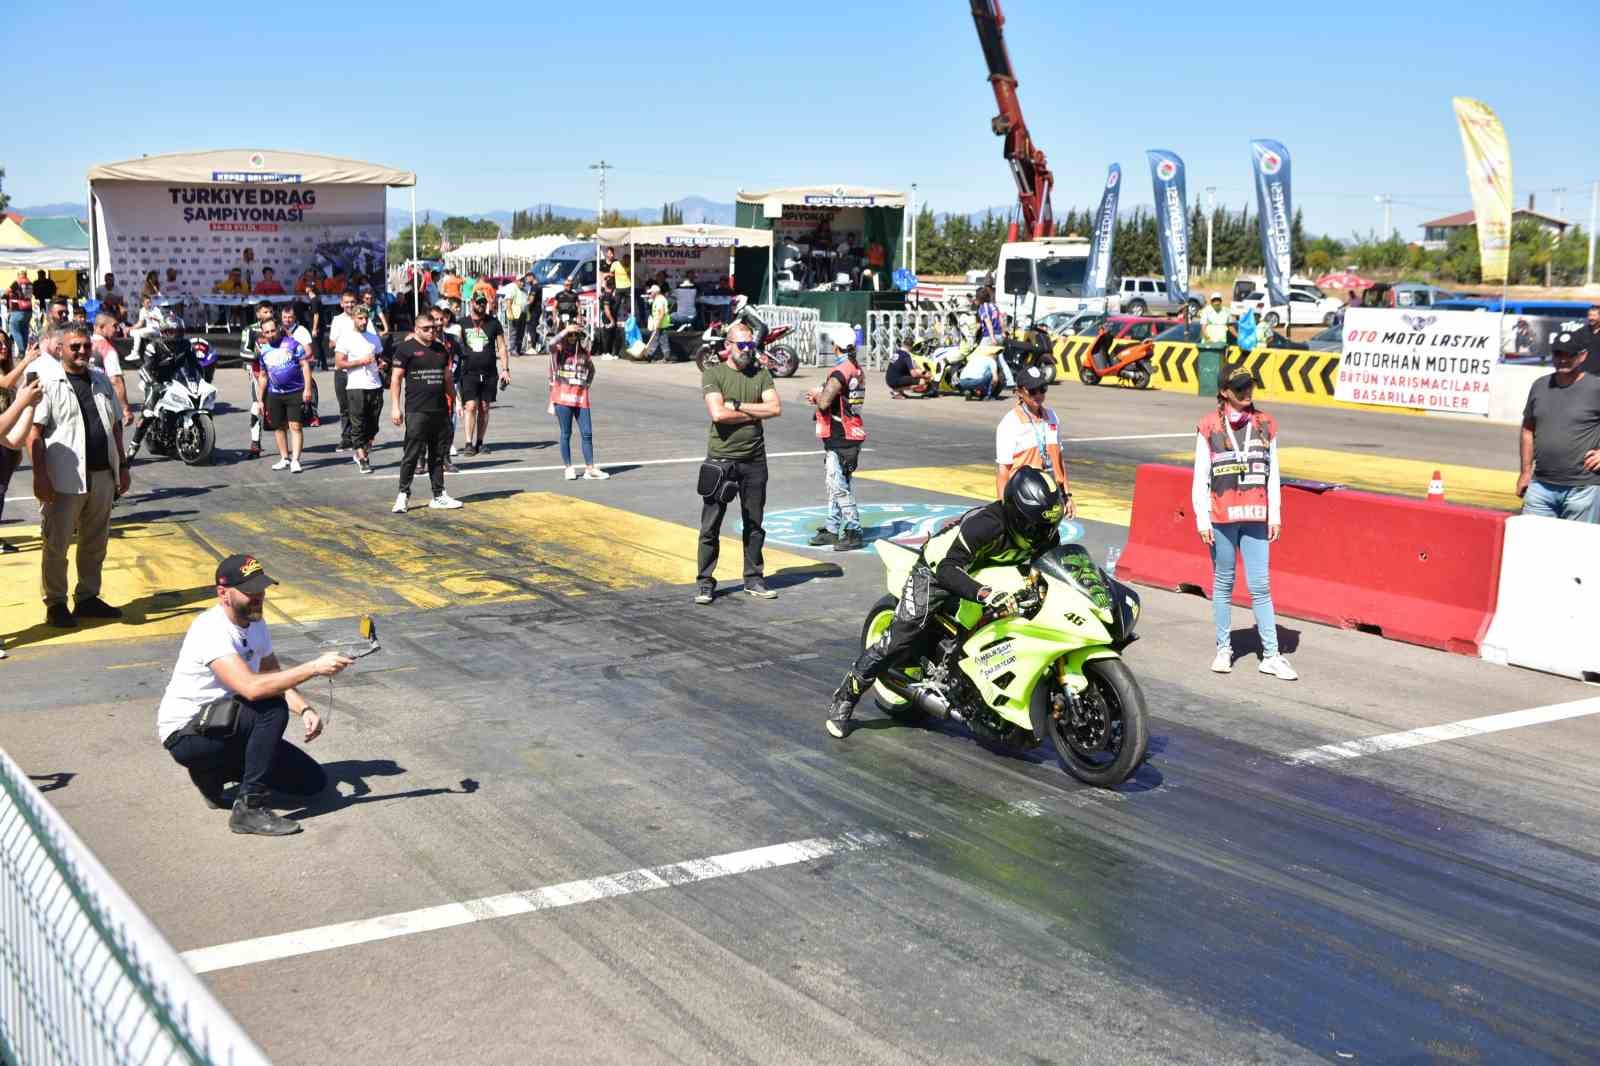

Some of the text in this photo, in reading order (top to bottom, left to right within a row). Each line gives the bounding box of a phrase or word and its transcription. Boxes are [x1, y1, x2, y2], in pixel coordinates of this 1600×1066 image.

[168, 187, 316, 205] TÜRKİYE DRAG
[183, 208, 304, 223] ŞAMPİYONASI
[1347, 330, 1490, 349] OTO MOTO LASTIK
[1426, 356, 1490, 375] MOTORS
[1353, 388, 1469, 408] BASARILAR DILER
[1064, 612, 1086, 627] 46
